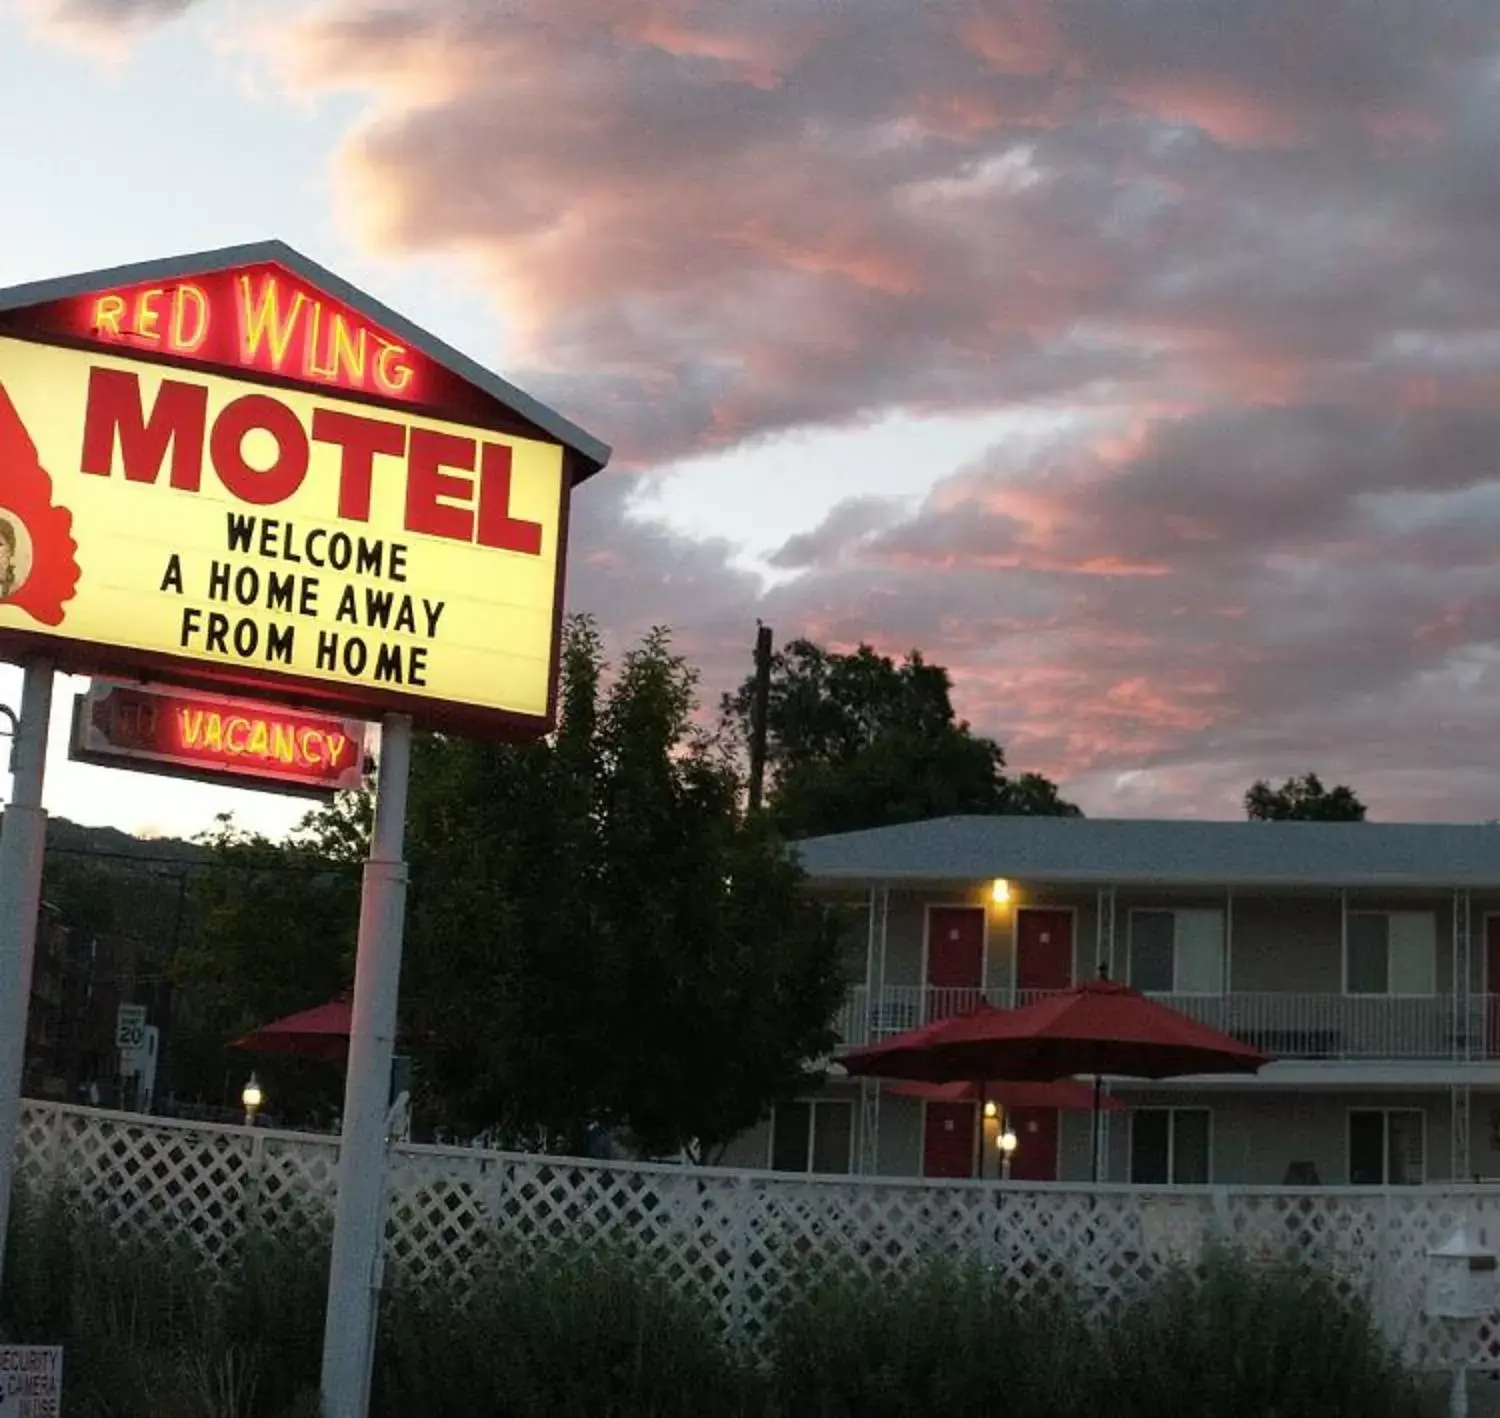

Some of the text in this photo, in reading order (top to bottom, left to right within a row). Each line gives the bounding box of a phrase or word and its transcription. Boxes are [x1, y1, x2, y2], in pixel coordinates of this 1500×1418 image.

[95, 274, 414, 390] RED WING
[81, 365, 542, 556] MOTEL
[226, 512, 408, 582] WELCOME
[160, 554, 445, 639] A HOME AWAY
[180, 608, 428, 687] FROM HOME
[178, 706, 345, 767] VACANCY
[119, 1026, 142, 1045] 20
[0, 1349, 57, 1371] ECURITY
[8, 1374, 56, 1396] CAMERA
